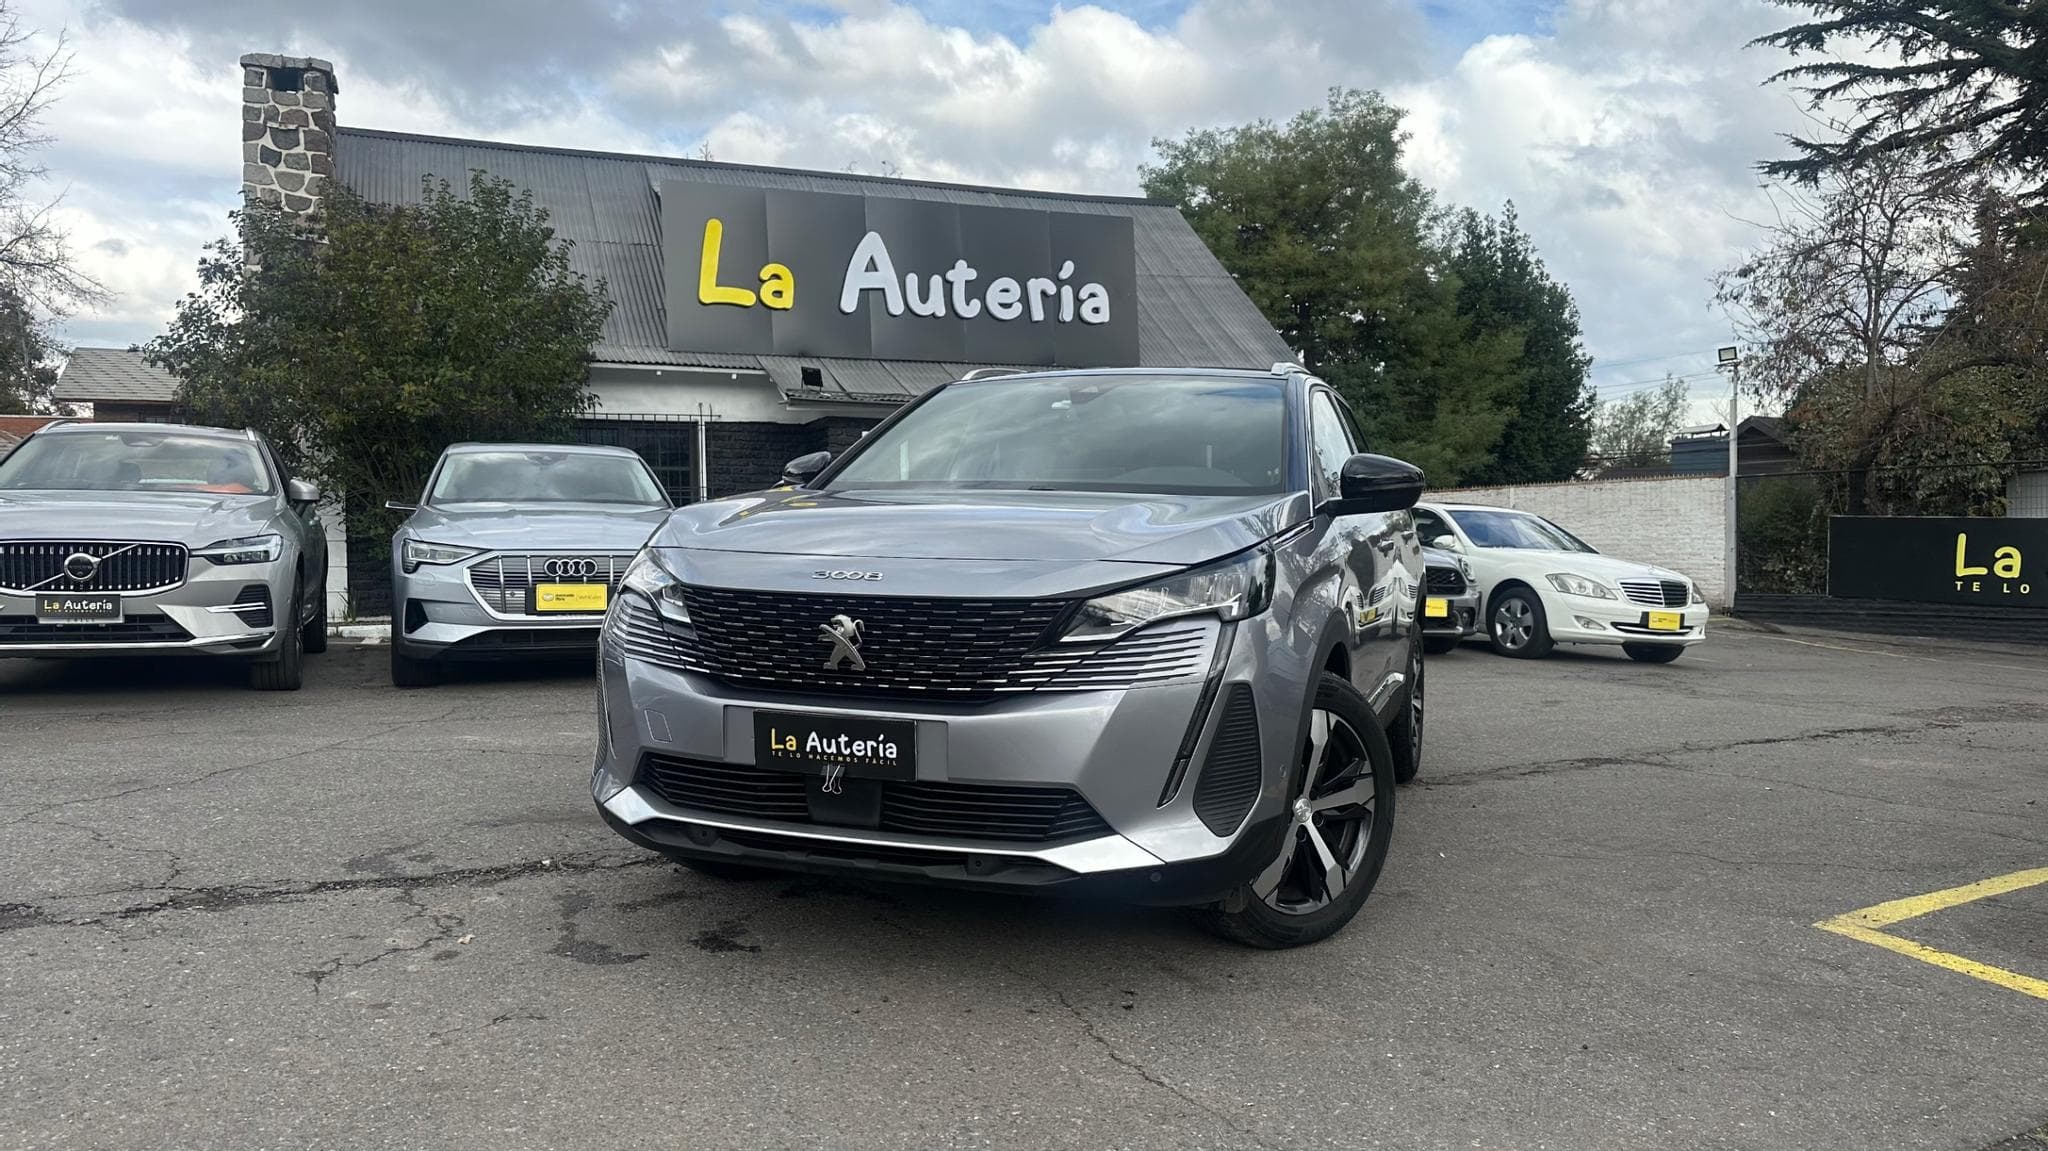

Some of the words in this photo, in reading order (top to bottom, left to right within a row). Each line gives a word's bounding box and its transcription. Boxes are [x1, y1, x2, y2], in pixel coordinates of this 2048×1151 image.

[698, 218, 795, 311] La
[839, 231, 1111, 324] Autería
[1955, 533, 2022, 578] La
[811, 570, 884, 582] 3008
[1955, 581, 1981, 592] TE
[2003, 583, 2030, 594] LO
[44, 599, 60, 610] La
[771, 727, 797, 751] La
[805, 730, 897, 759] Autería
[808, 753, 859, 763] HACEMOS
